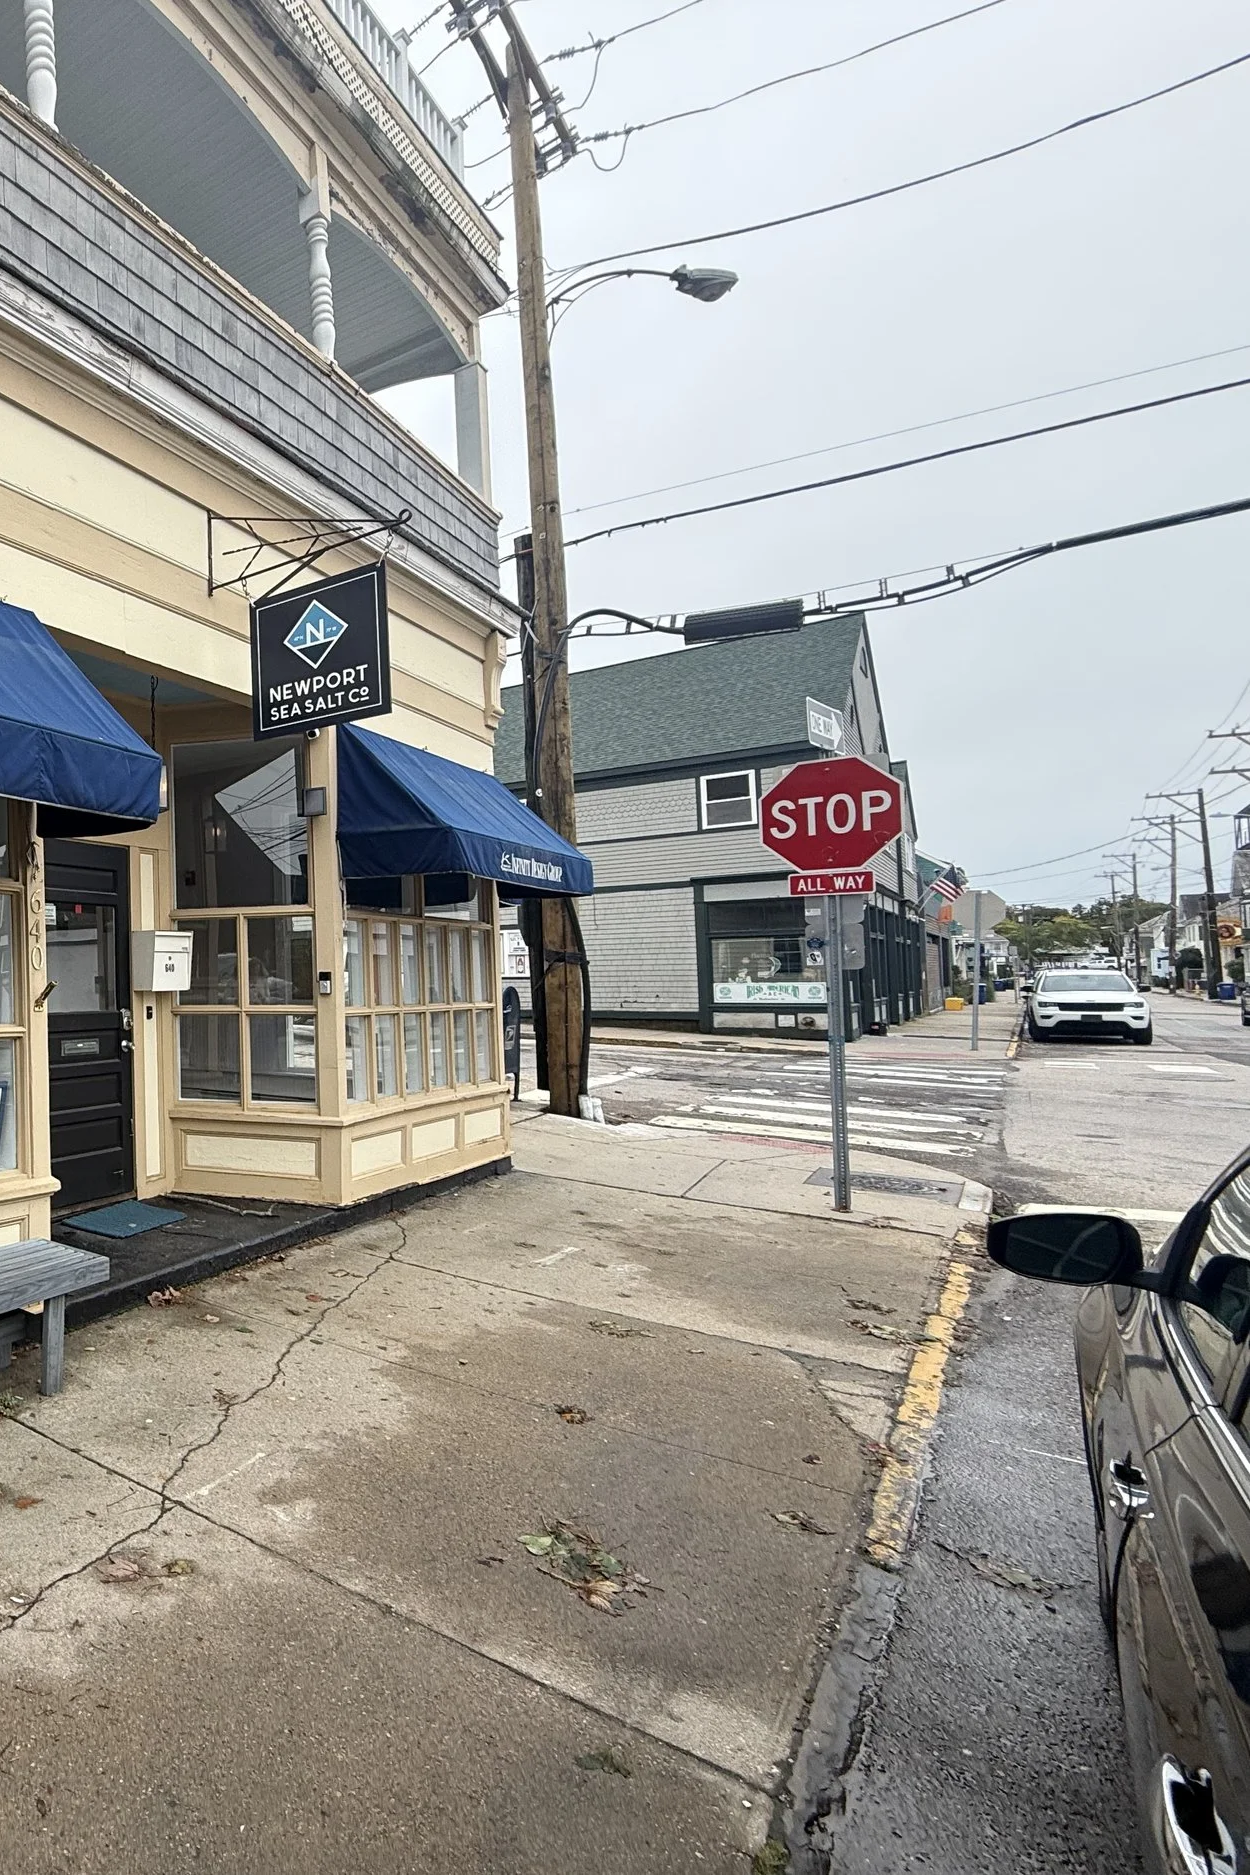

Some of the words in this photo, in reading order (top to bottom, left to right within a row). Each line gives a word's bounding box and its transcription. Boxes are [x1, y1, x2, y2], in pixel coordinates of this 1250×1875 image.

[305, 618, 325, 645] N
[269, 664, 369, 703] NEWPORT
[270, 702, 302, 721] SEA
[304, 692, 345, 713] SALT
[811, 713, 823, 733] ONE
[769, 789, 892, 840] STOP
[797, 878, 826, 892] ALL
[833, 875, 866, 890] WAY
[30, 889, 43, 970] 640
